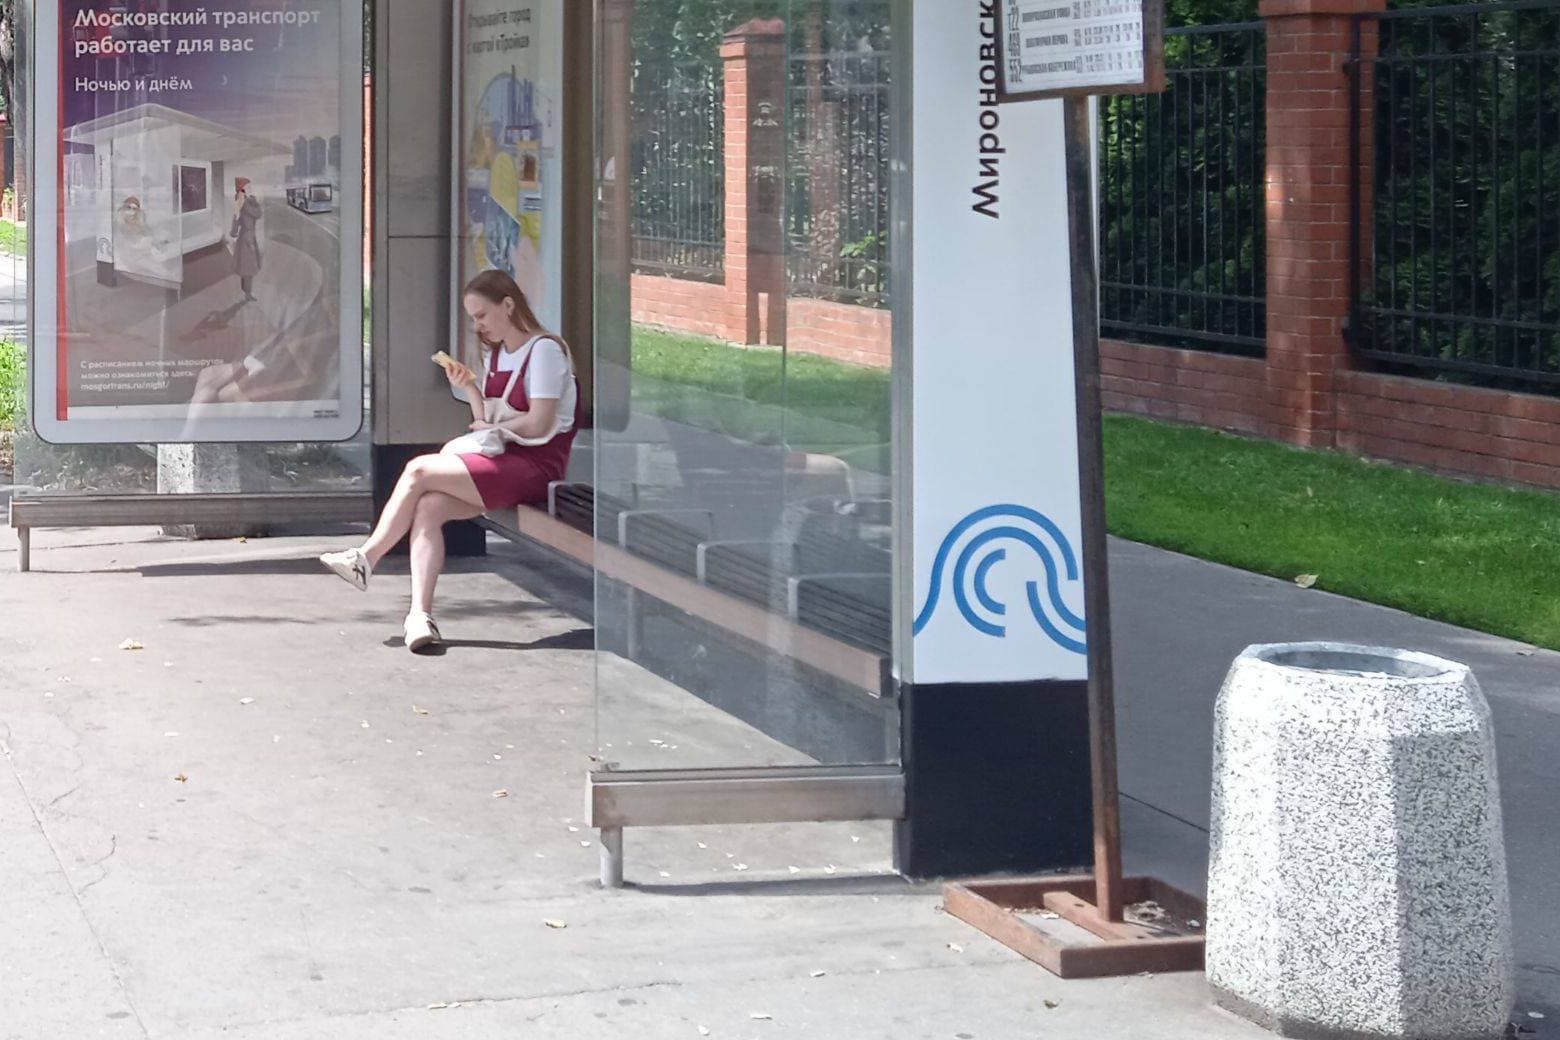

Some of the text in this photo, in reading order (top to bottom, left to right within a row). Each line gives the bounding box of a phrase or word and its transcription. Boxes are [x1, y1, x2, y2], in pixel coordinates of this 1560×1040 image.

[74, 8, 320, 28] Московский транспорт
[75, 36, 254, 57] работает для вас
[75, 76, 193, 92] Ночью и днём
